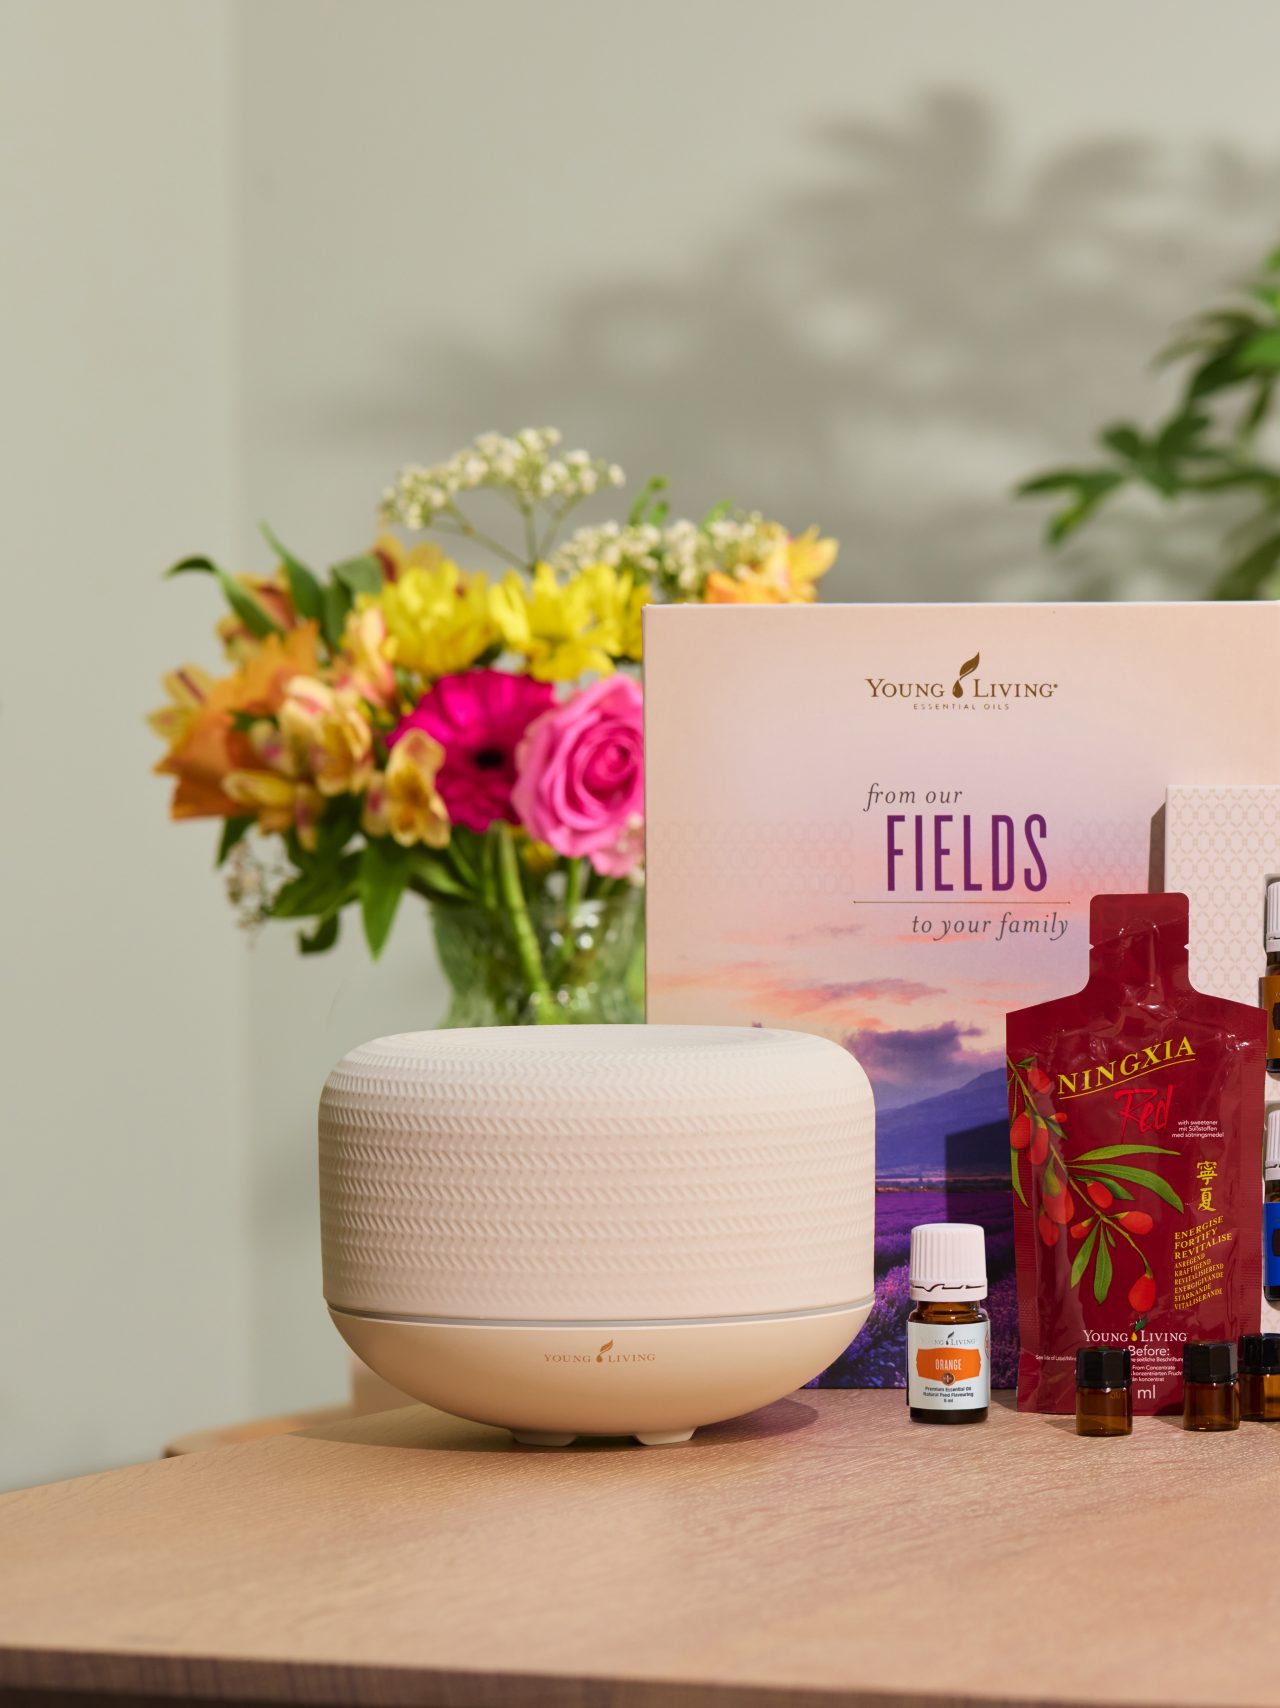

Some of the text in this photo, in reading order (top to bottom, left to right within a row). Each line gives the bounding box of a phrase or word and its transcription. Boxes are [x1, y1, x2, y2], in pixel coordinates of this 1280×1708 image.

[865, 678, 1055, 698] YOUNG LIVING
[863, 783, 963, 812] from our
[886, 814, 1048, 892] FIELDS
[912, 912, 1068, 941] to your family
[1057, 1035, 1196, 1096] NINGXIA
[1114, 1084, 1177, 1143] Red
[1174, 1215, 1224, 1240] ENERGISE
[1174, 1226, 1218, 1250] FORTIFY
[1174, 1233, 1233, 1260] REVITALISE
[1082, 1330, 1188, 1342] YOUNG LIVING
[544, 1353, 656, 1363] YOUNG LIVING
[1128, 1345, 1170, 1356] Before:
[935, 1358, 962, 1371] ORANGE
[1137, 1384, 1156, 1399] ml
